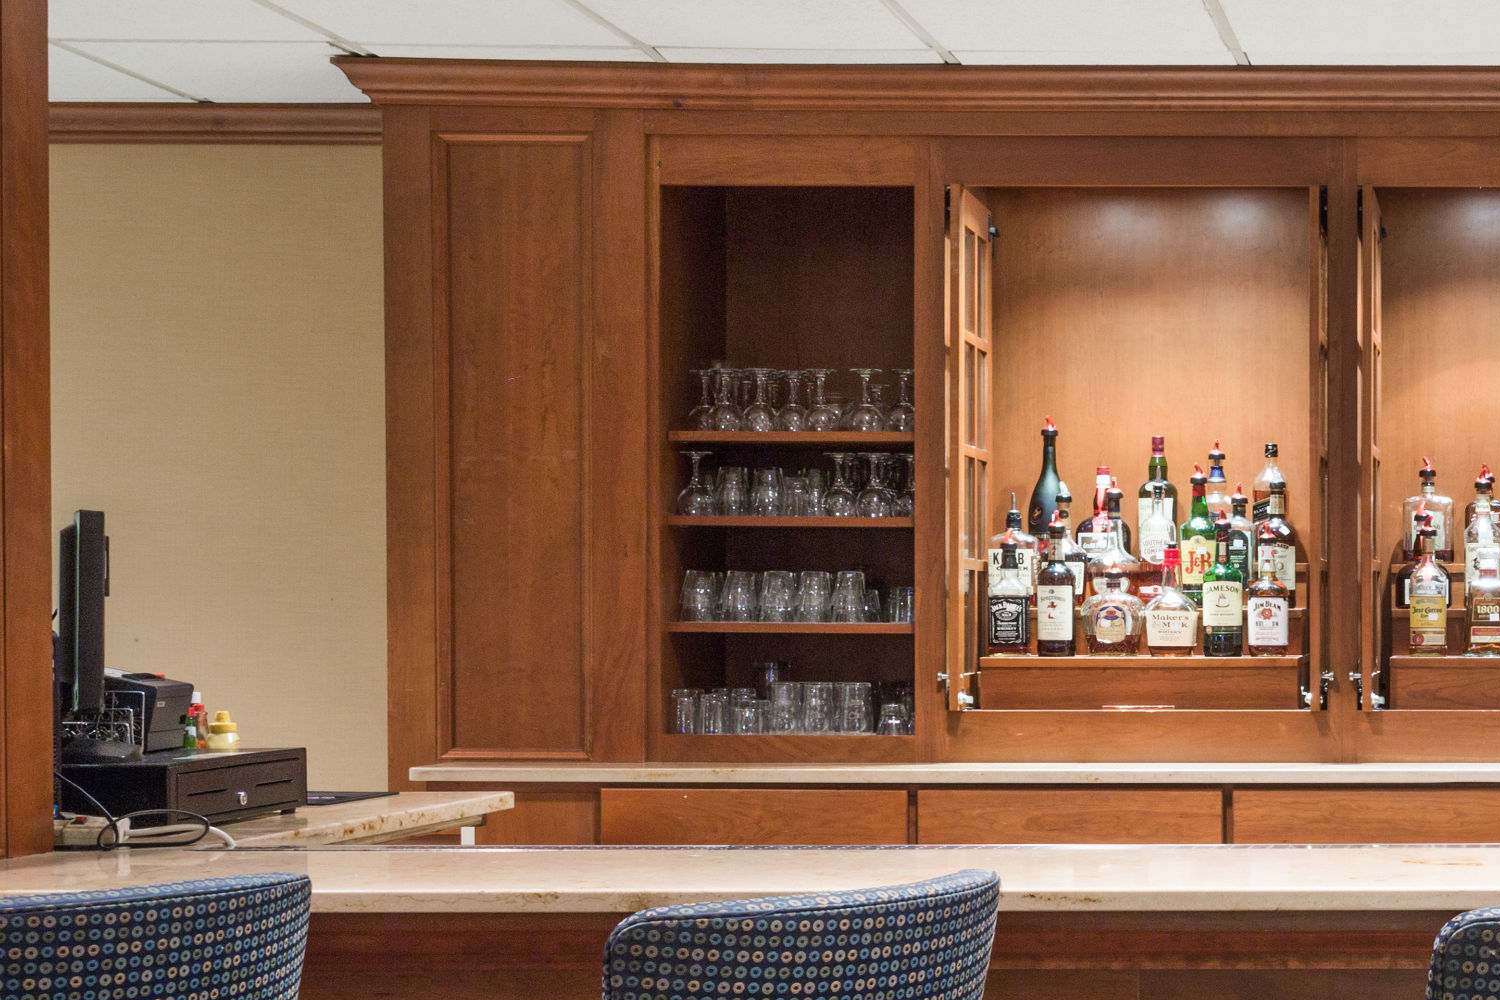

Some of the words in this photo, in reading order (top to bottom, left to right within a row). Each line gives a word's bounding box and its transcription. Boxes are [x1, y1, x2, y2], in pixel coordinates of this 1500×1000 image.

[993, 552, 1025, 565] KB
[1207, 584, 1239, 593] JAMESON
[1253, 601, 1264, 611] JIM
[1265, 600, 1282, 611] BEAM
[1476, 605, 1500, 615] 1800
[1152, 614, 1190, 622] Maker's
